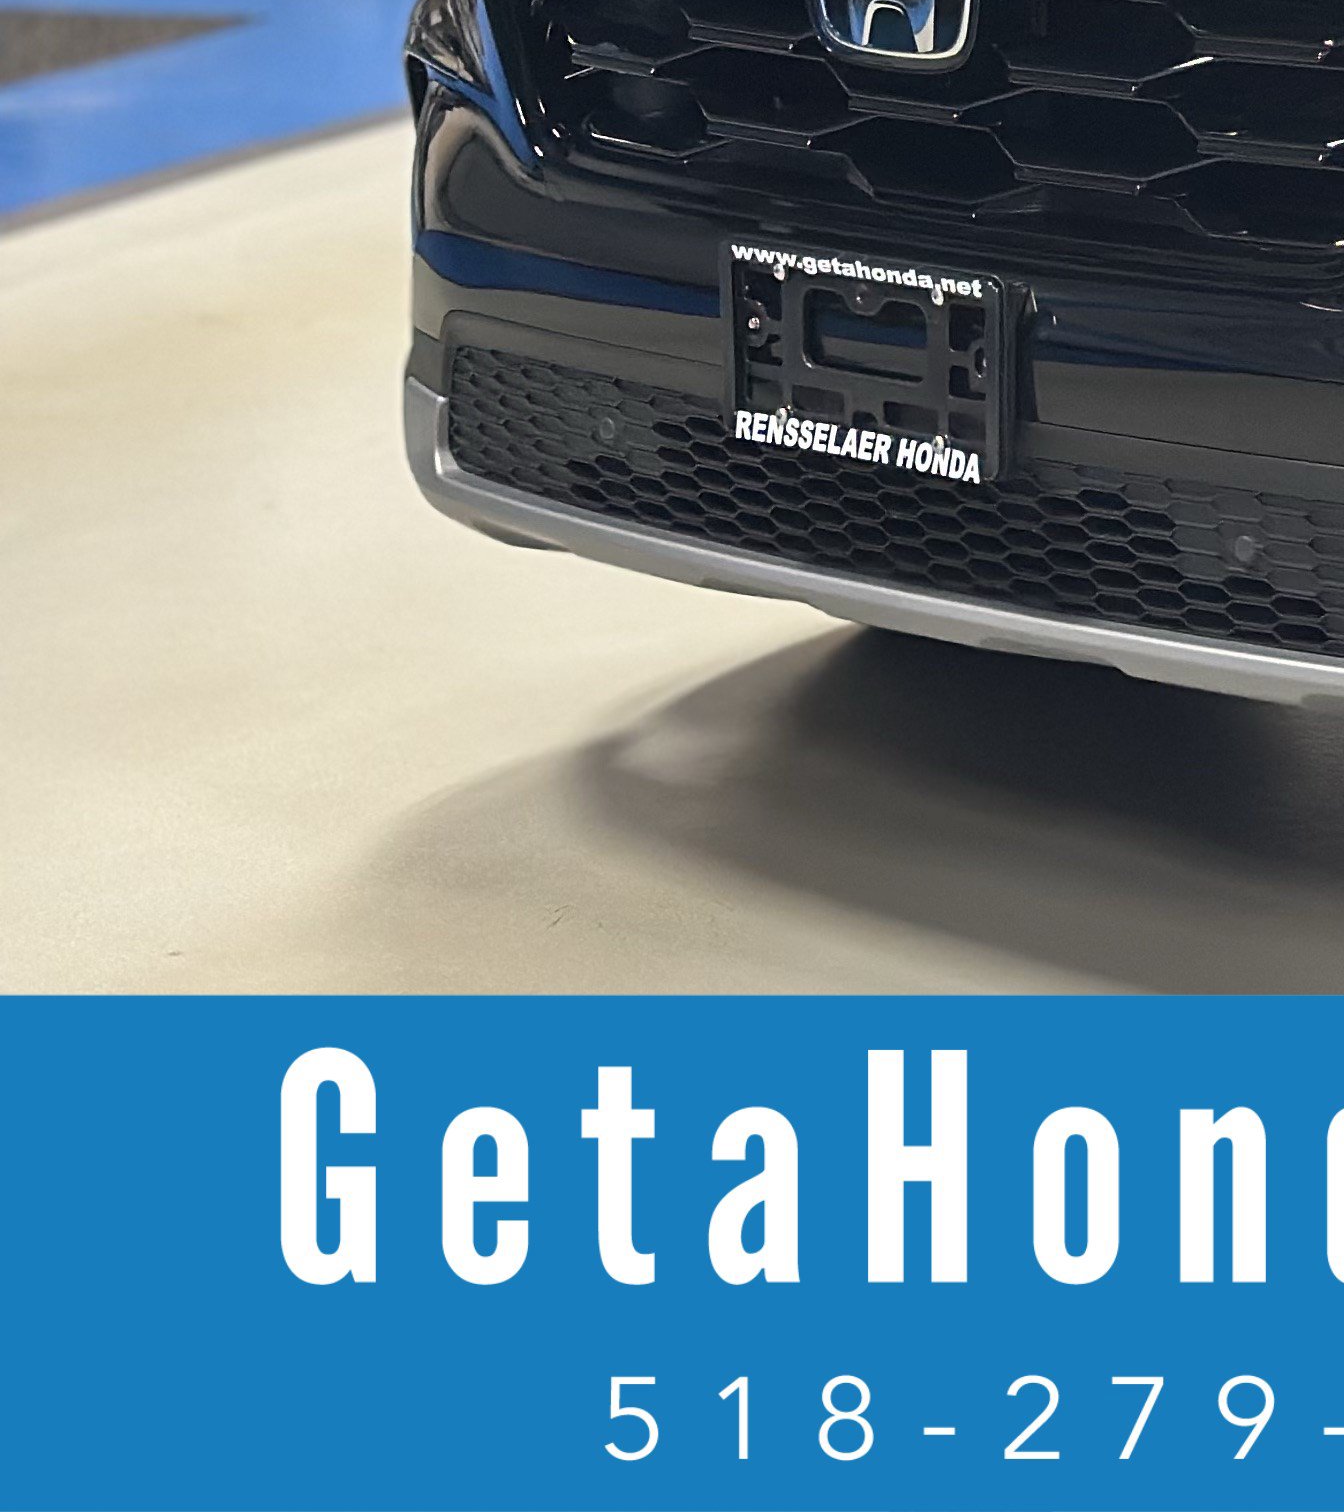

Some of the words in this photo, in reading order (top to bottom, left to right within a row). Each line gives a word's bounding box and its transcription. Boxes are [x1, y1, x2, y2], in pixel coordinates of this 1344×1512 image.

[731, 244, 983, 298] www.getahonda.net
[734, 409, 892, 465] RENSSELAER
[896, 436, 981, 484] HONDA
